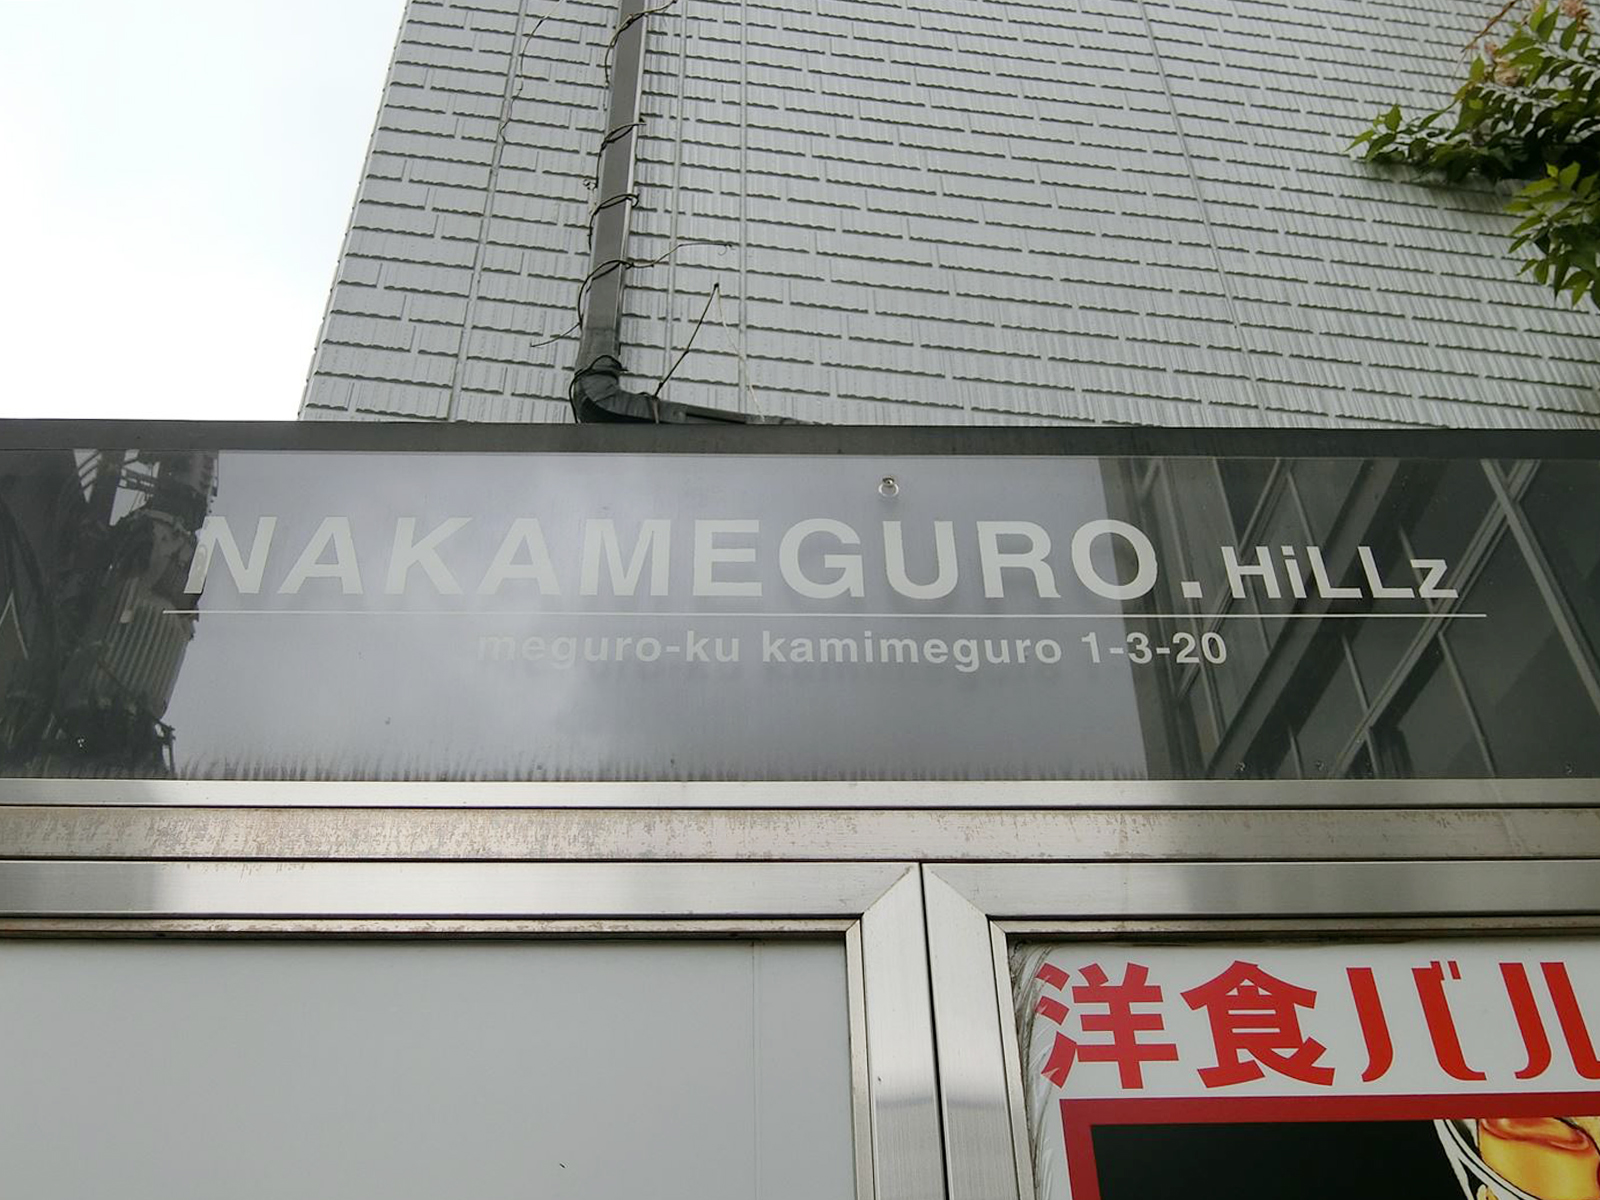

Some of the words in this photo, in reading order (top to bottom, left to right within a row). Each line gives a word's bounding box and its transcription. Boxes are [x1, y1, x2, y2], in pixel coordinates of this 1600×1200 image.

[477, 630, 740, 671] meguro-ku
[762, 630, 1062, 673] kamimeguro
[1082, 632, 1227, 665] 1-3-20
[1036, 960, 1600, 1089] 洋食バル
